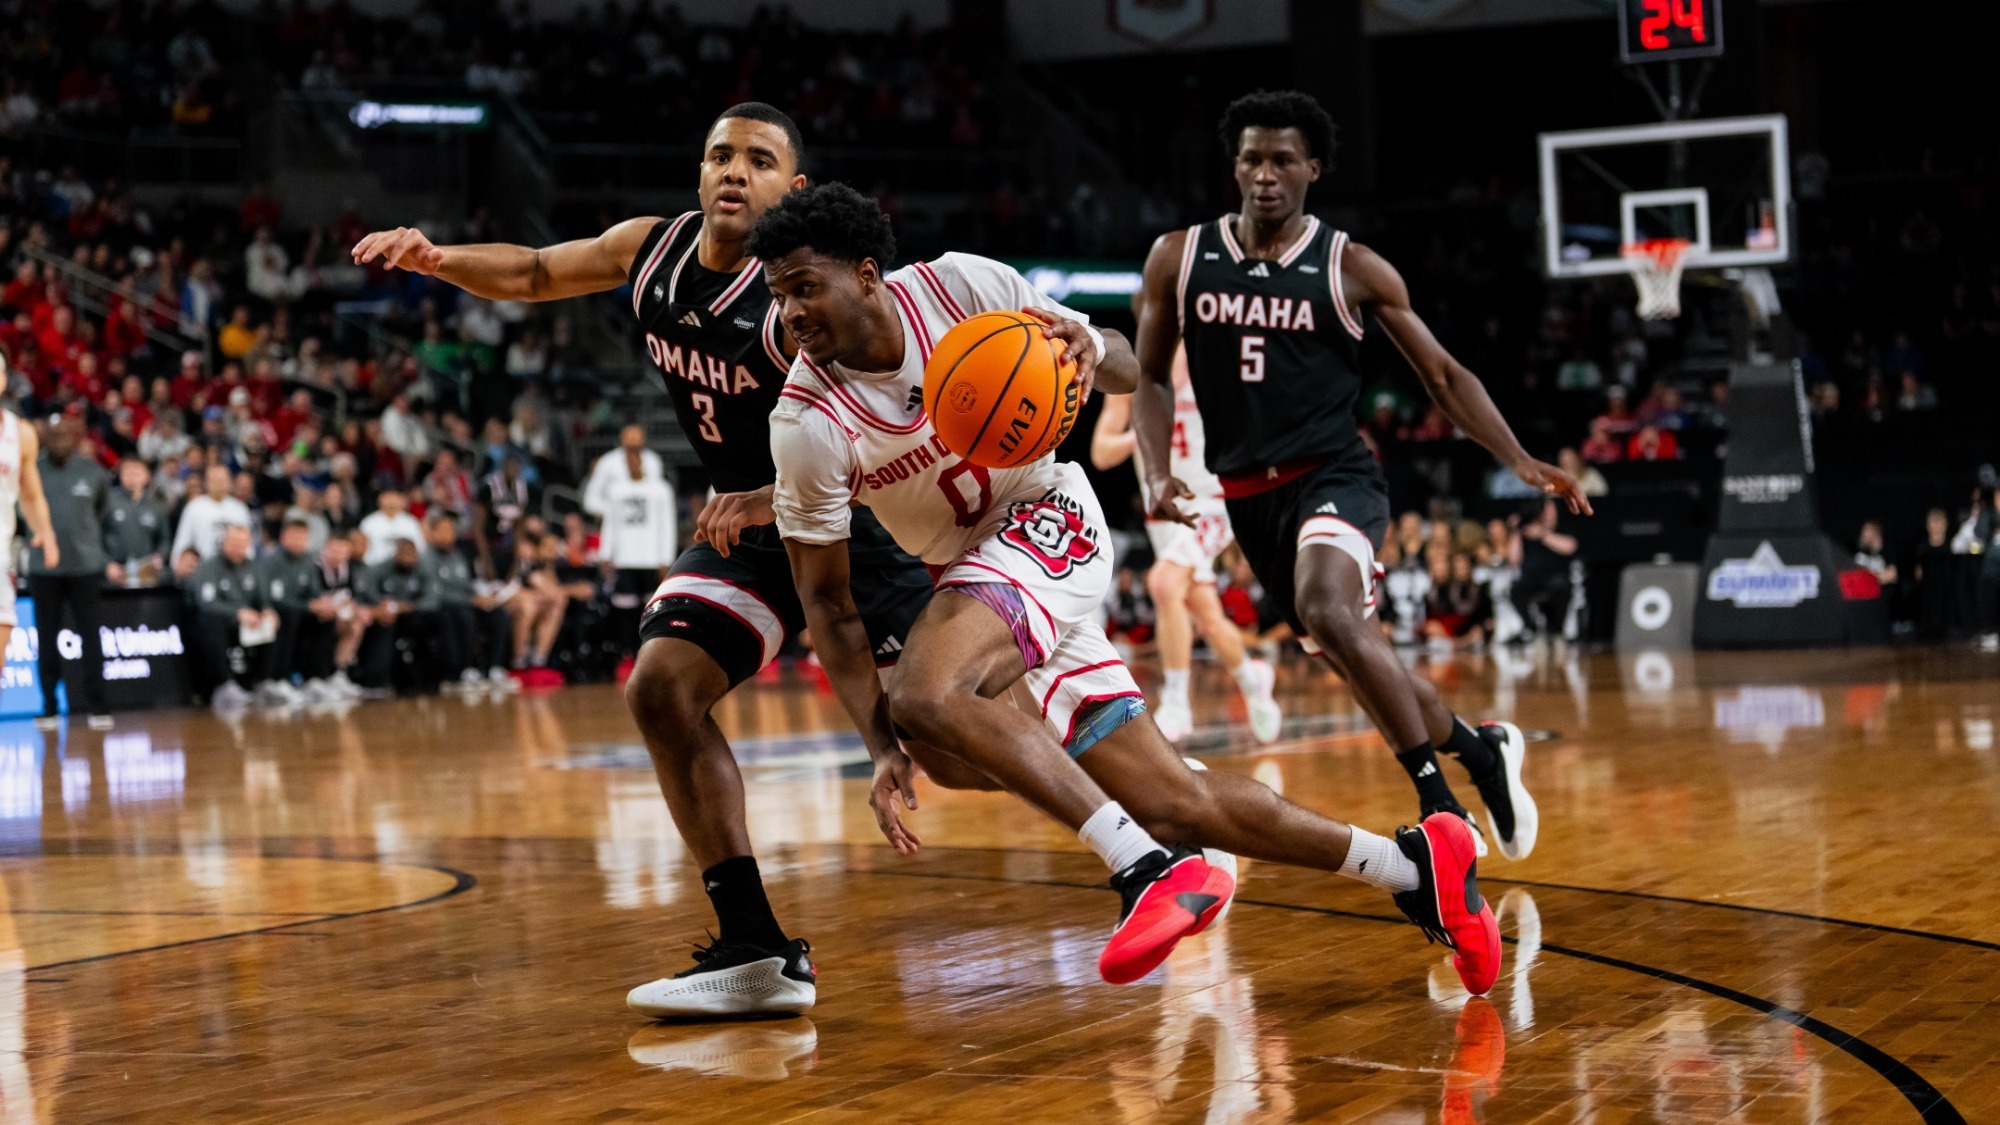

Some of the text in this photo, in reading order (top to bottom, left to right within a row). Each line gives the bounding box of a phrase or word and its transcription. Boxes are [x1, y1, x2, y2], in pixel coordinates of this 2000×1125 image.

[1640, 0, 1705, 50] 24
[1195, 291, 1316, 332] OMAHA
[645, 331, 761, 396] OMAHA
[1240, 335, 1265, 382] 5
[690, 390, 724, 444] 3
[864, 443, 936, 490] SOUTH
[936, 458, 993, 529] 0
